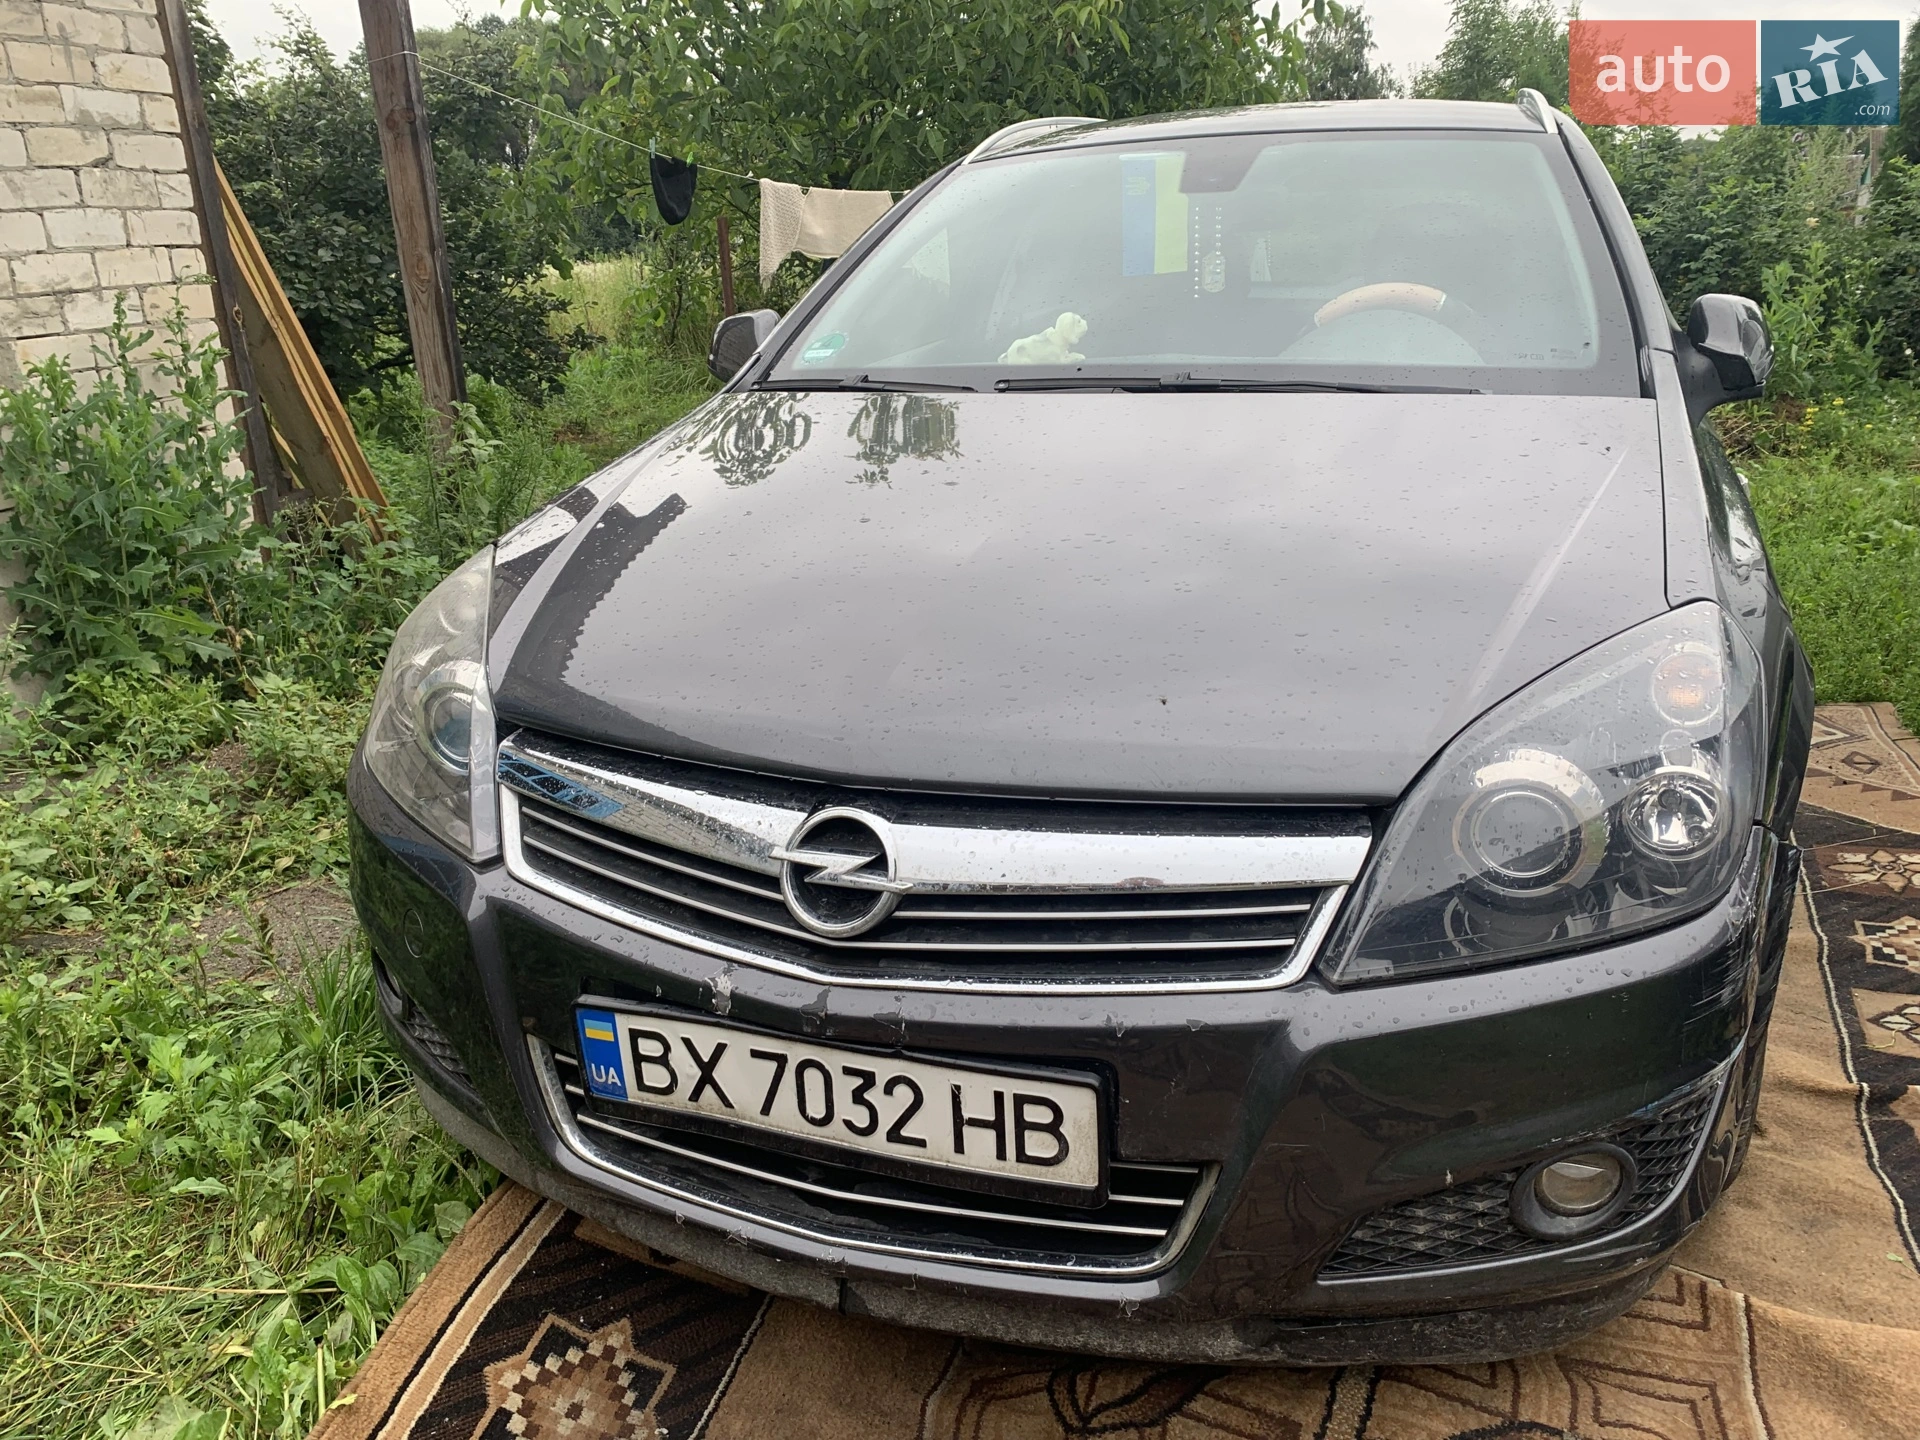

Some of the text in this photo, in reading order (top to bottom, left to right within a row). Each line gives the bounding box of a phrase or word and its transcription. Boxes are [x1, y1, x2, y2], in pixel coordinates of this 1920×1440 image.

[592, 1063, 622, 1087] UA
[628, 1027, 1070, 1167] BX 7032 HB
